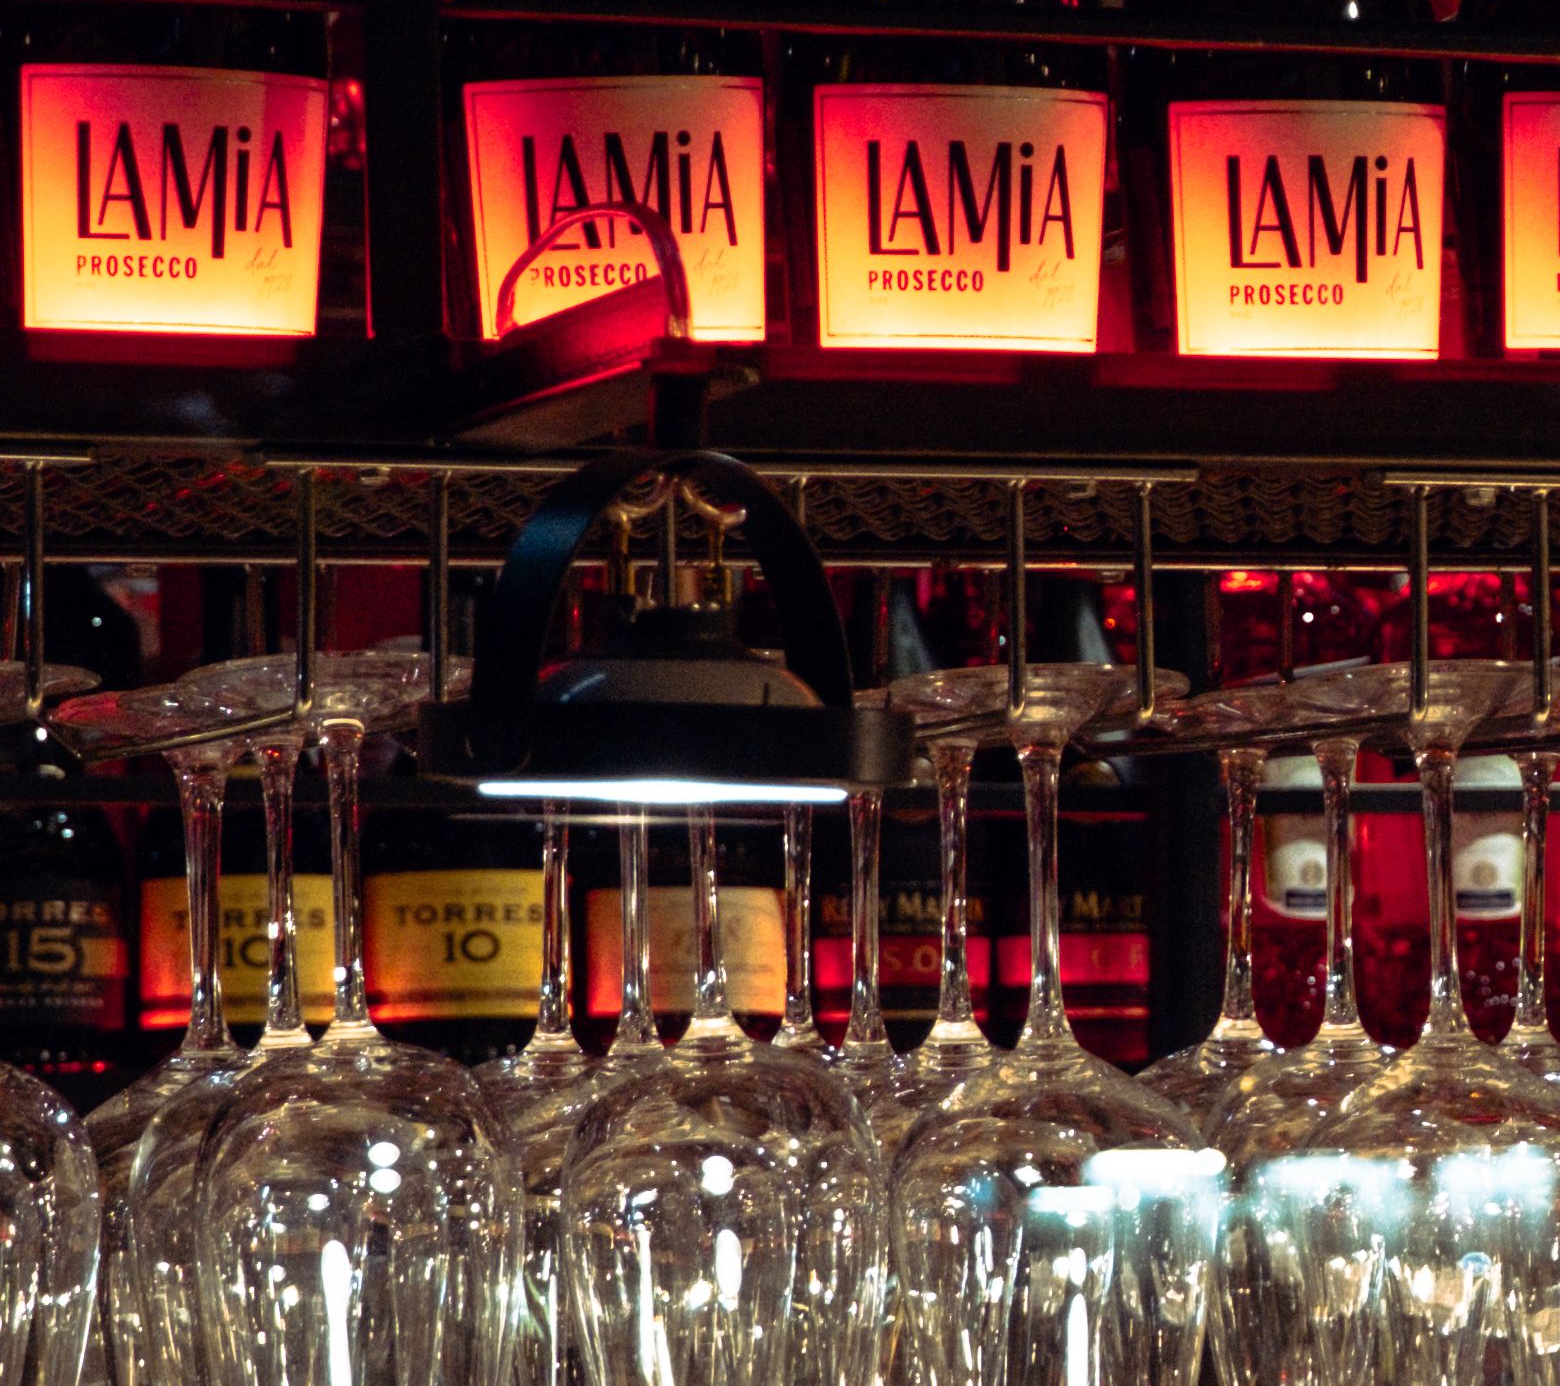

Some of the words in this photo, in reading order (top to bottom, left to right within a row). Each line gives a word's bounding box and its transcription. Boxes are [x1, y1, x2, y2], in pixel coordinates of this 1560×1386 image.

[76, 255, 198, 281] PROSECCO
[529, 263, 649, 290] PROSECCO
[868, 269, 984, 293] PROSECCO
[1229, 284, 1345, 306] PROSECCO
[396, 902, 542, 926] TORRES
[5, 926, 78, 975] 15
[444, 929, 501, 964] 10
